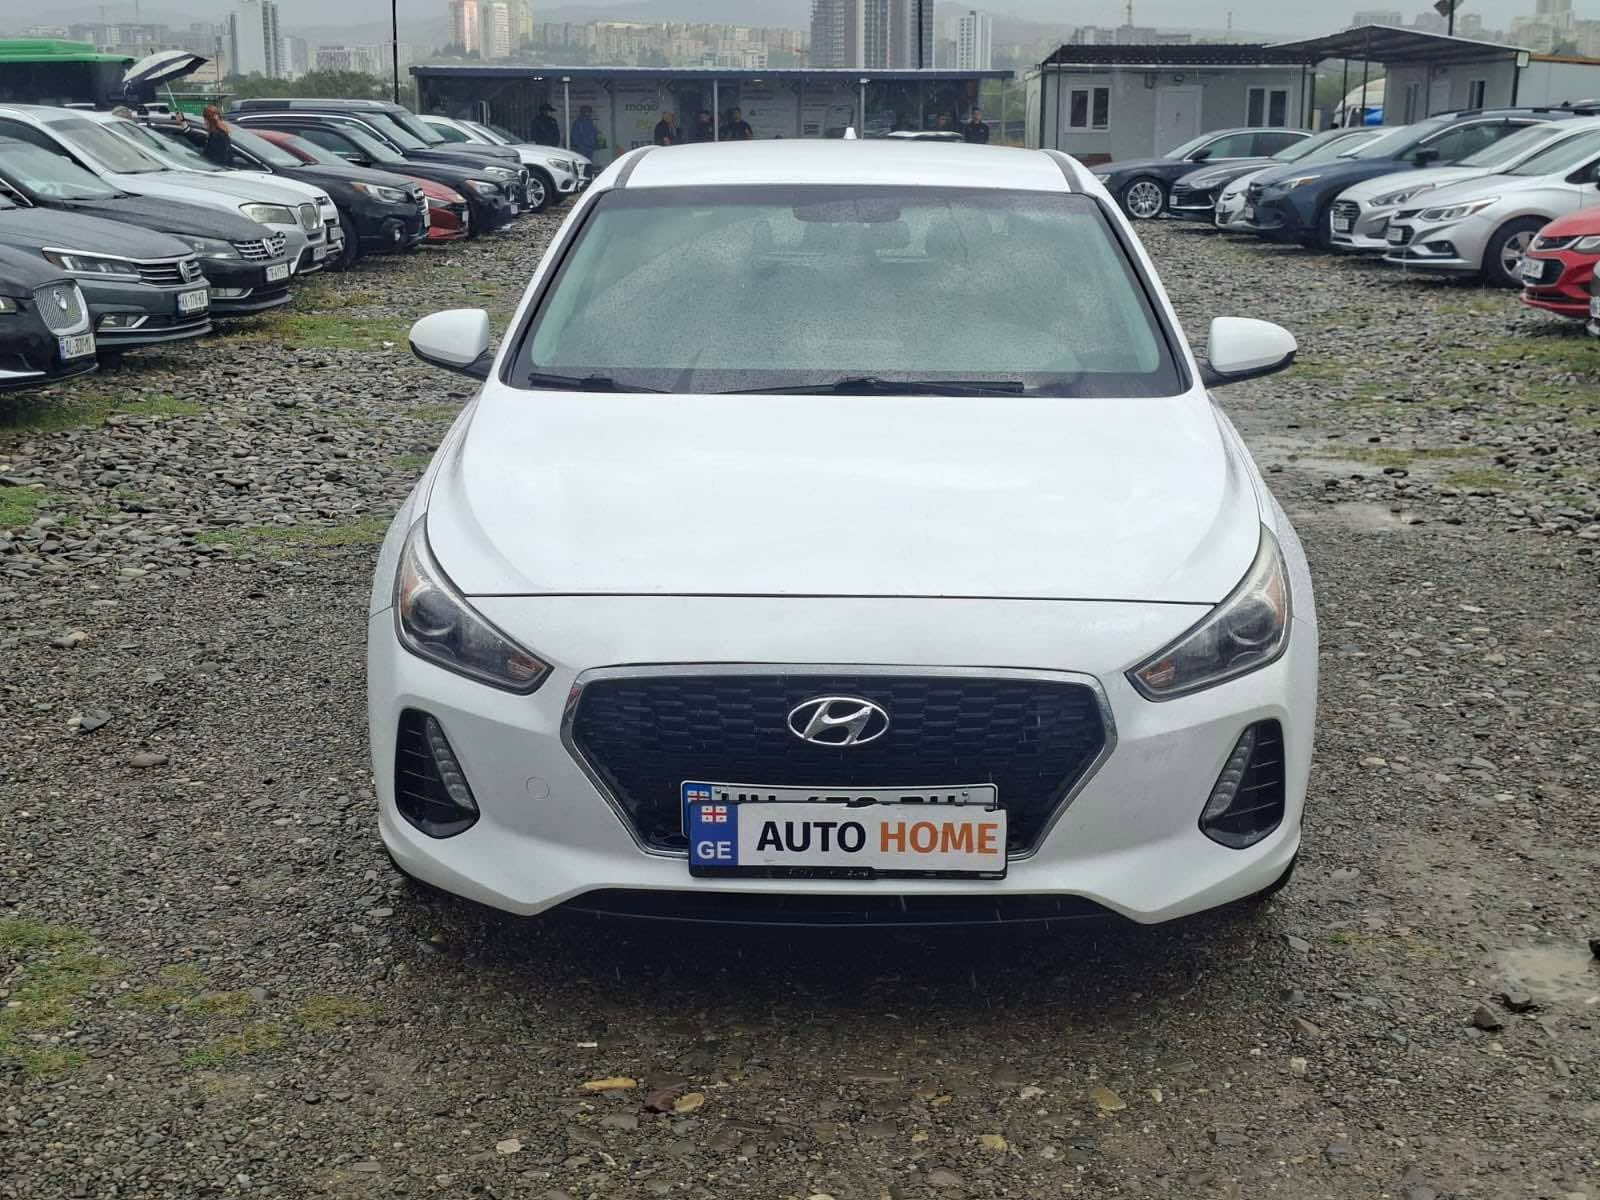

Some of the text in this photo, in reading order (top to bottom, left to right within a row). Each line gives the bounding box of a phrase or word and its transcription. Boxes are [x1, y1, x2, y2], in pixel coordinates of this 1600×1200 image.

[756, 820, 998, 854] AUTO HOME
[697, 841, 732, 860] GE
